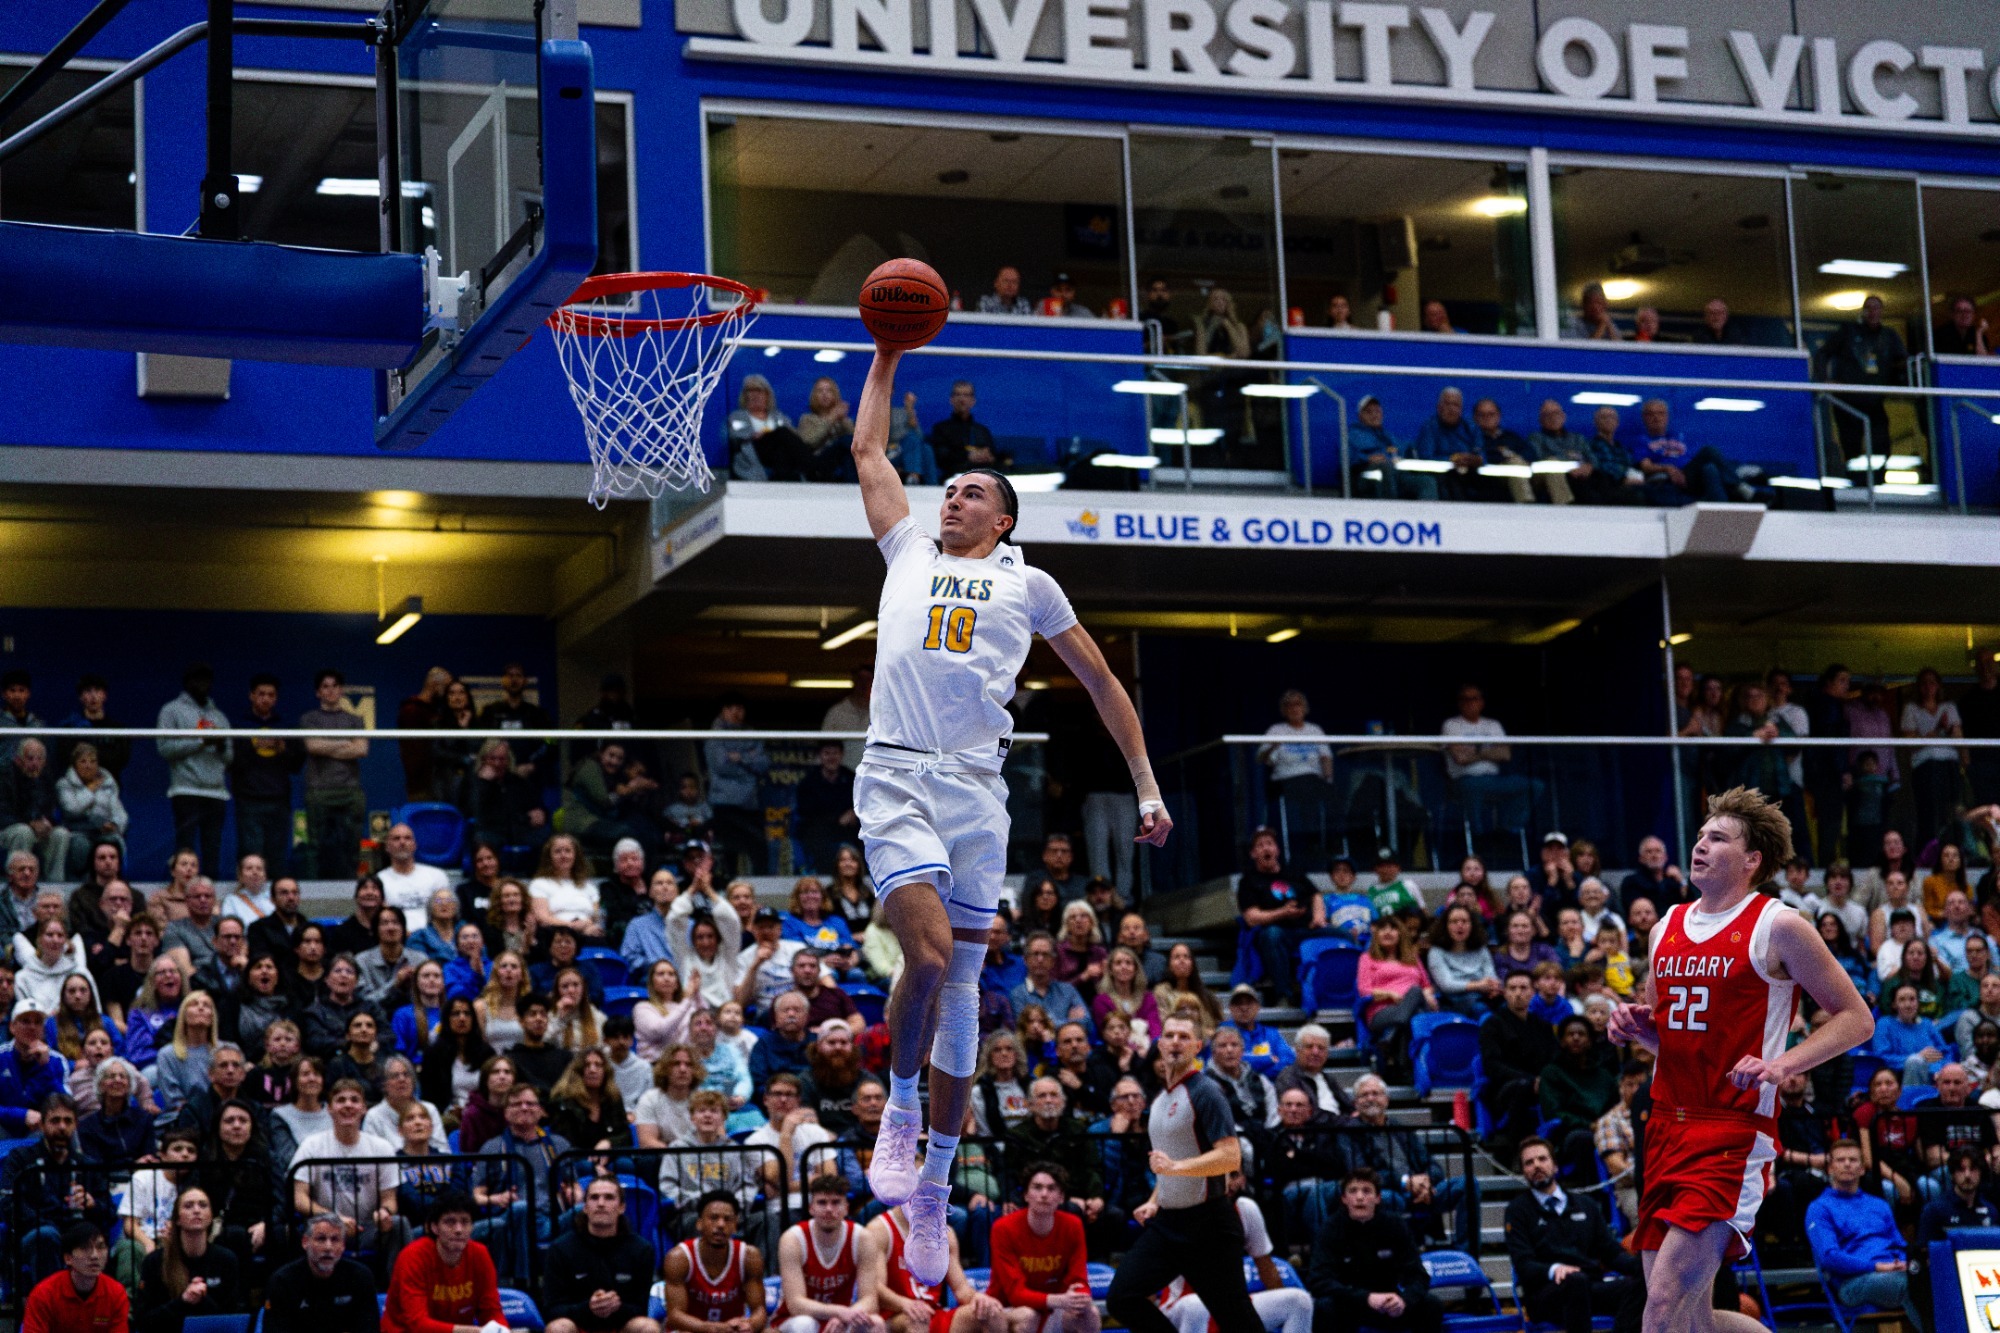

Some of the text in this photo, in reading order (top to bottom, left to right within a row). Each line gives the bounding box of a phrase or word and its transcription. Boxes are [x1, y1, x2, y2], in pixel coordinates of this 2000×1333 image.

[734, 0, 2000, 124] UNIVERSITY OF VICT
[871, 286, 931, 305] Wilson
[1114, 514, 1442, 546] BLUE & GOLD ROOM
[929, 574, 994, 602] VIKES
[922, 603, 978, 654] 10
[1656, 955, 1735, 978] CALGARY
[1667, 985, 1710, 1032] 22
